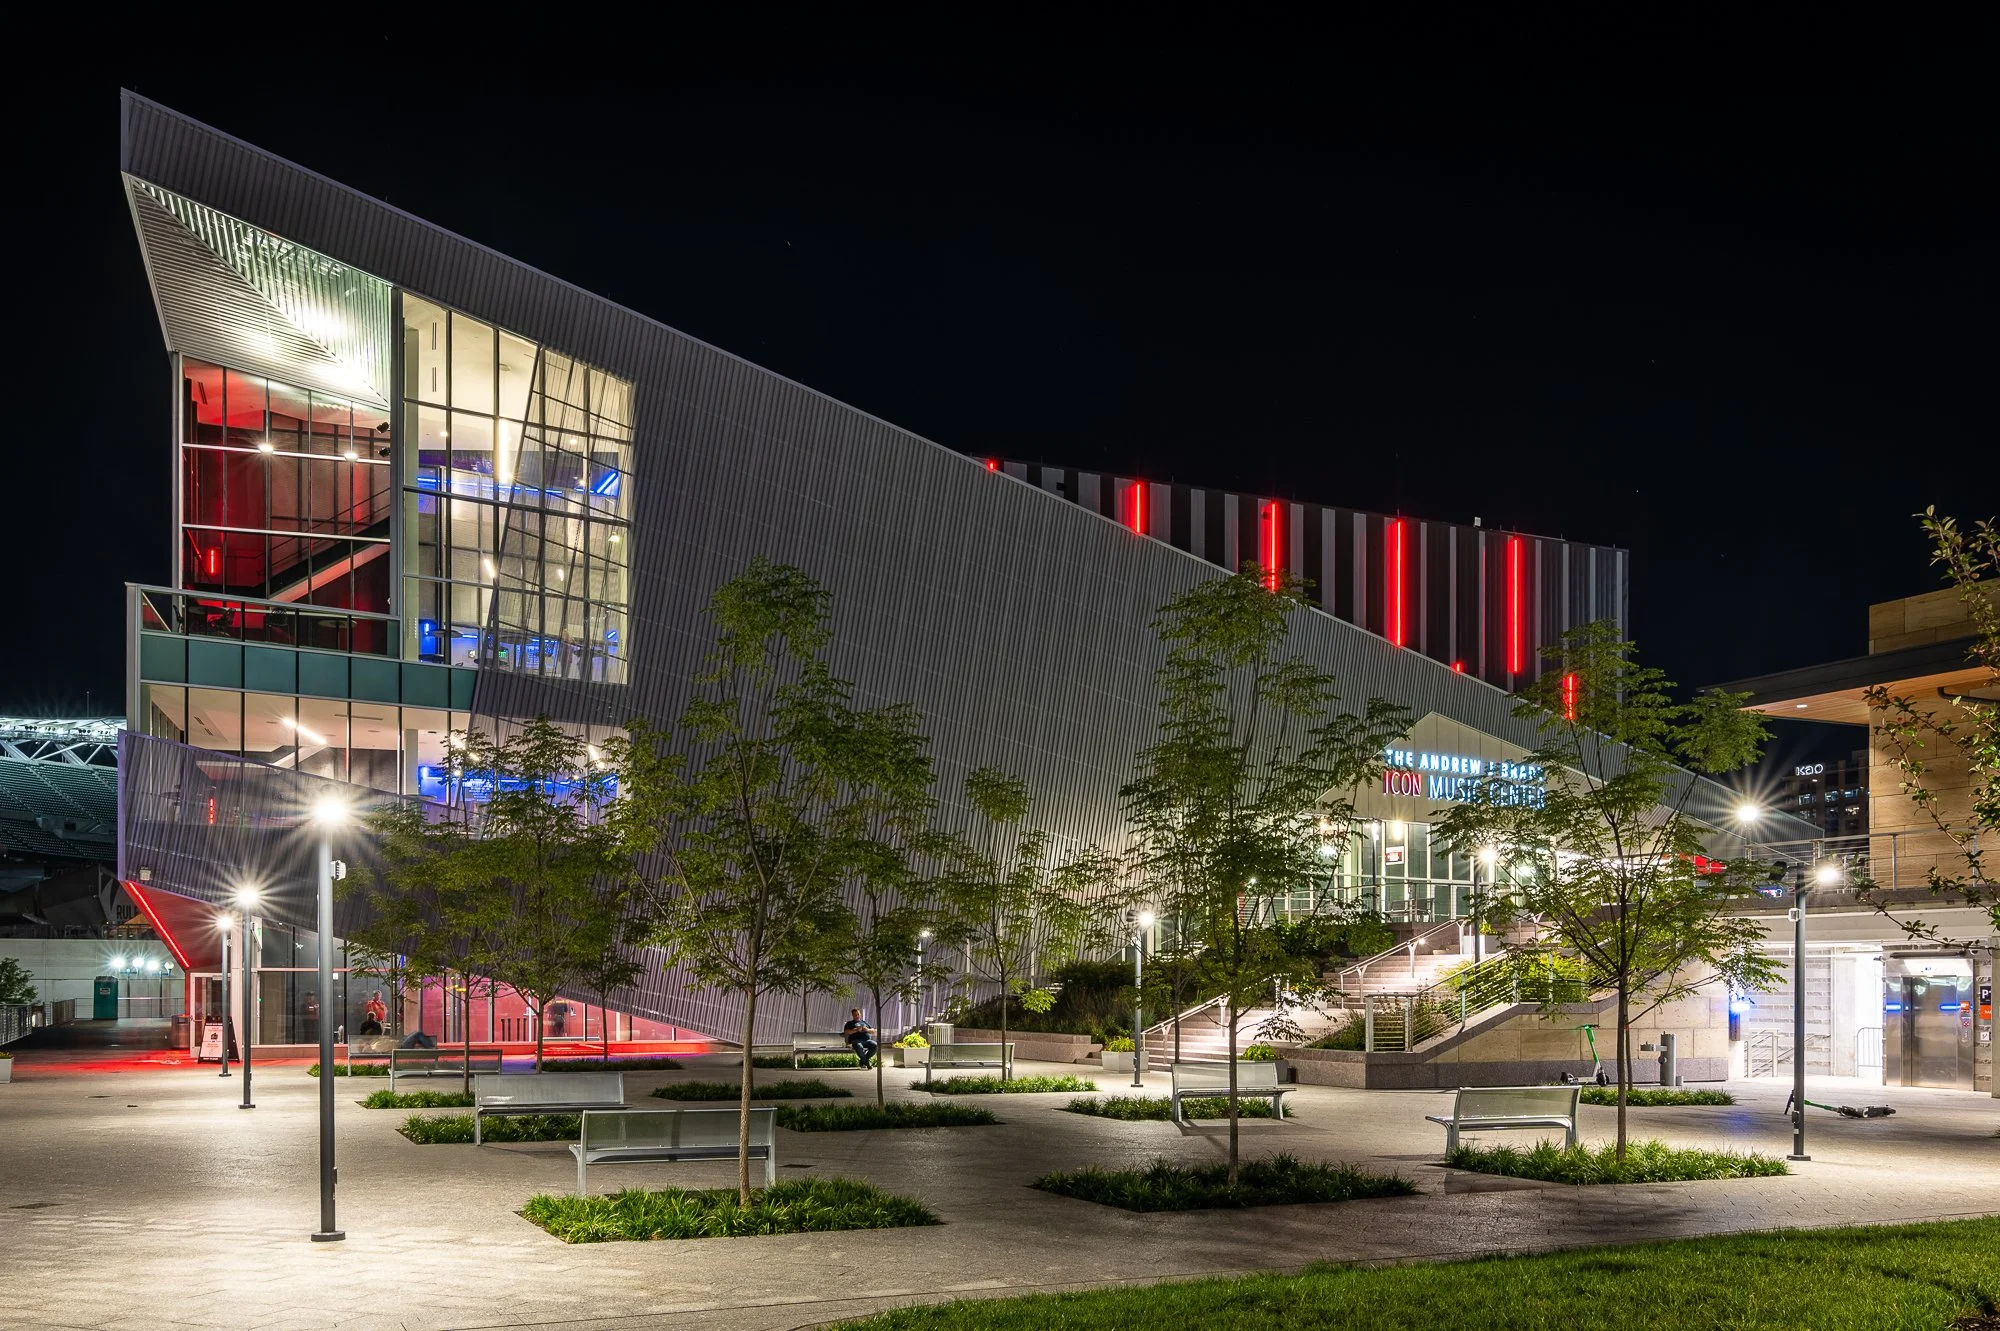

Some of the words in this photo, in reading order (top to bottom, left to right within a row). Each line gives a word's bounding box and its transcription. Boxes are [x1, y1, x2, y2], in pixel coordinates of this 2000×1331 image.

[1386, 749, 1414, 768] THE
[1418, 753, 1481, 776] ANDREW
[1383, 769, 1423, 797] ICON
[1428, 774, 1482, 804] MUSIC
[1489, 782, 1545, 809] CENTER
[1981, 989, 1992, 999] P
